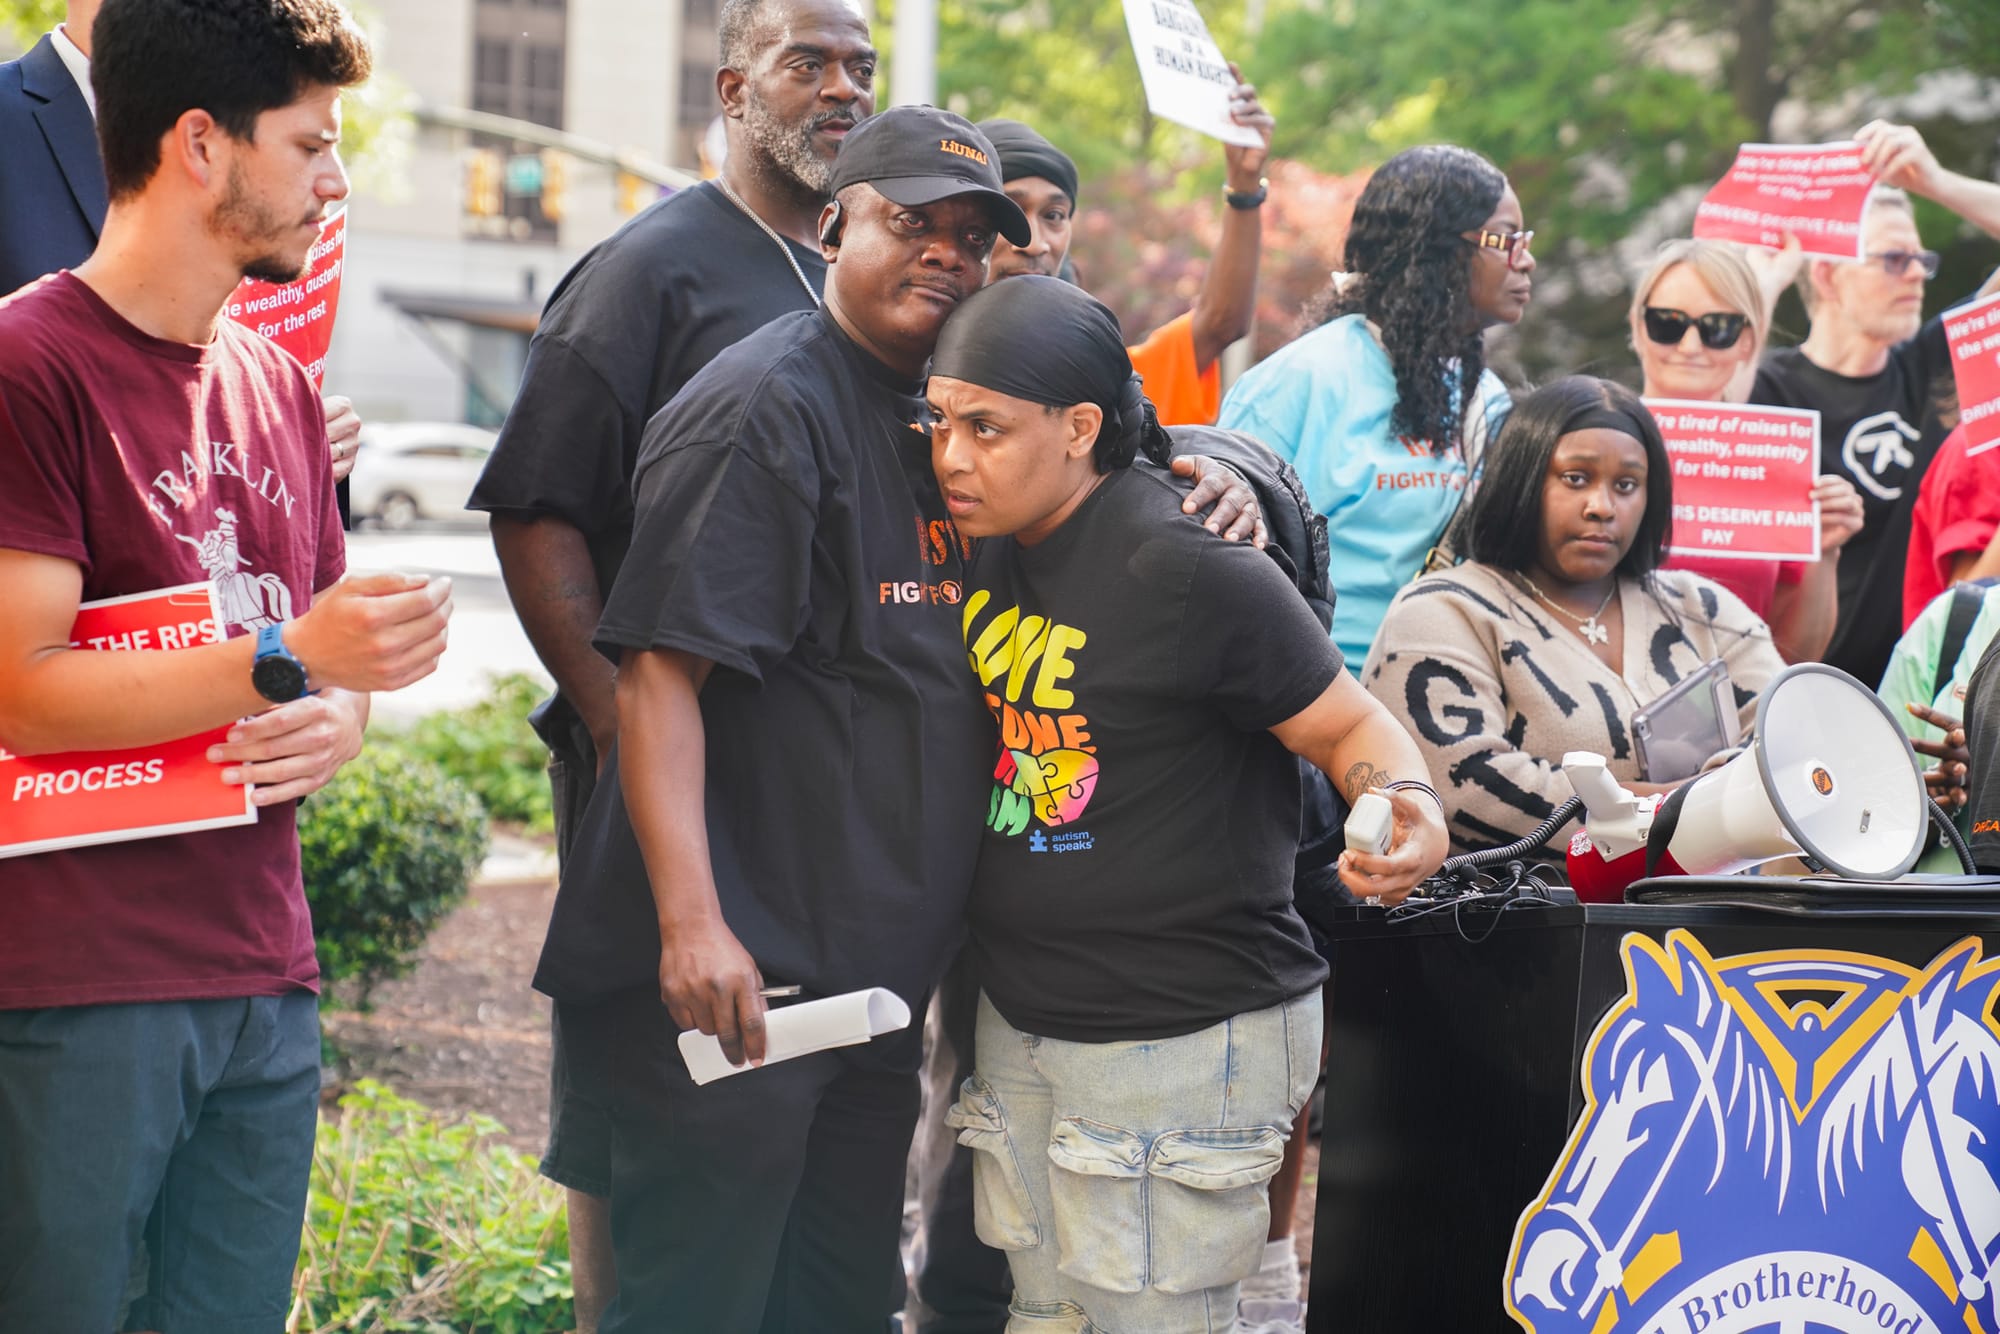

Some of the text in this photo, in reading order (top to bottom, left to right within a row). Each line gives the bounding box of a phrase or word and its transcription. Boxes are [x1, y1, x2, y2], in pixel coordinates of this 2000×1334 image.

[311, 238, 336, 262] aises
[245, 284, 305, 315] wealthy,
[305, 257, 342, 294] austerity
[257, 299, 327, 339] for the rest
[1948, 313, 1986, 341] We're
[1957, 339, 1983, 361] the
[1678, 413, 1719, 433] tired
[1720, 416, 1740, 433] of
[1740, 418, 1788, 437] raises
[1790, 422, 1814, 439] for
[1735, 443, 1809, 465] austerity
[1376, 471, 1436, 491] FIGHT
[1675, 458, 1766, 481] for the rest
[1697, 506, 1773, 527] DESERVE
[1776, 510, 1815, 527] FAIR
[1701, 528, 1735, 545] PAY
[88, 619, 219, 650] THE RPS
[963, 589, 1087, 710] LOVE
[12, 758, 164, 802] PROCESS
[1052, 831, 1090, 842] autism
[1679, 1262, 1923, 1334] Brotherhood
